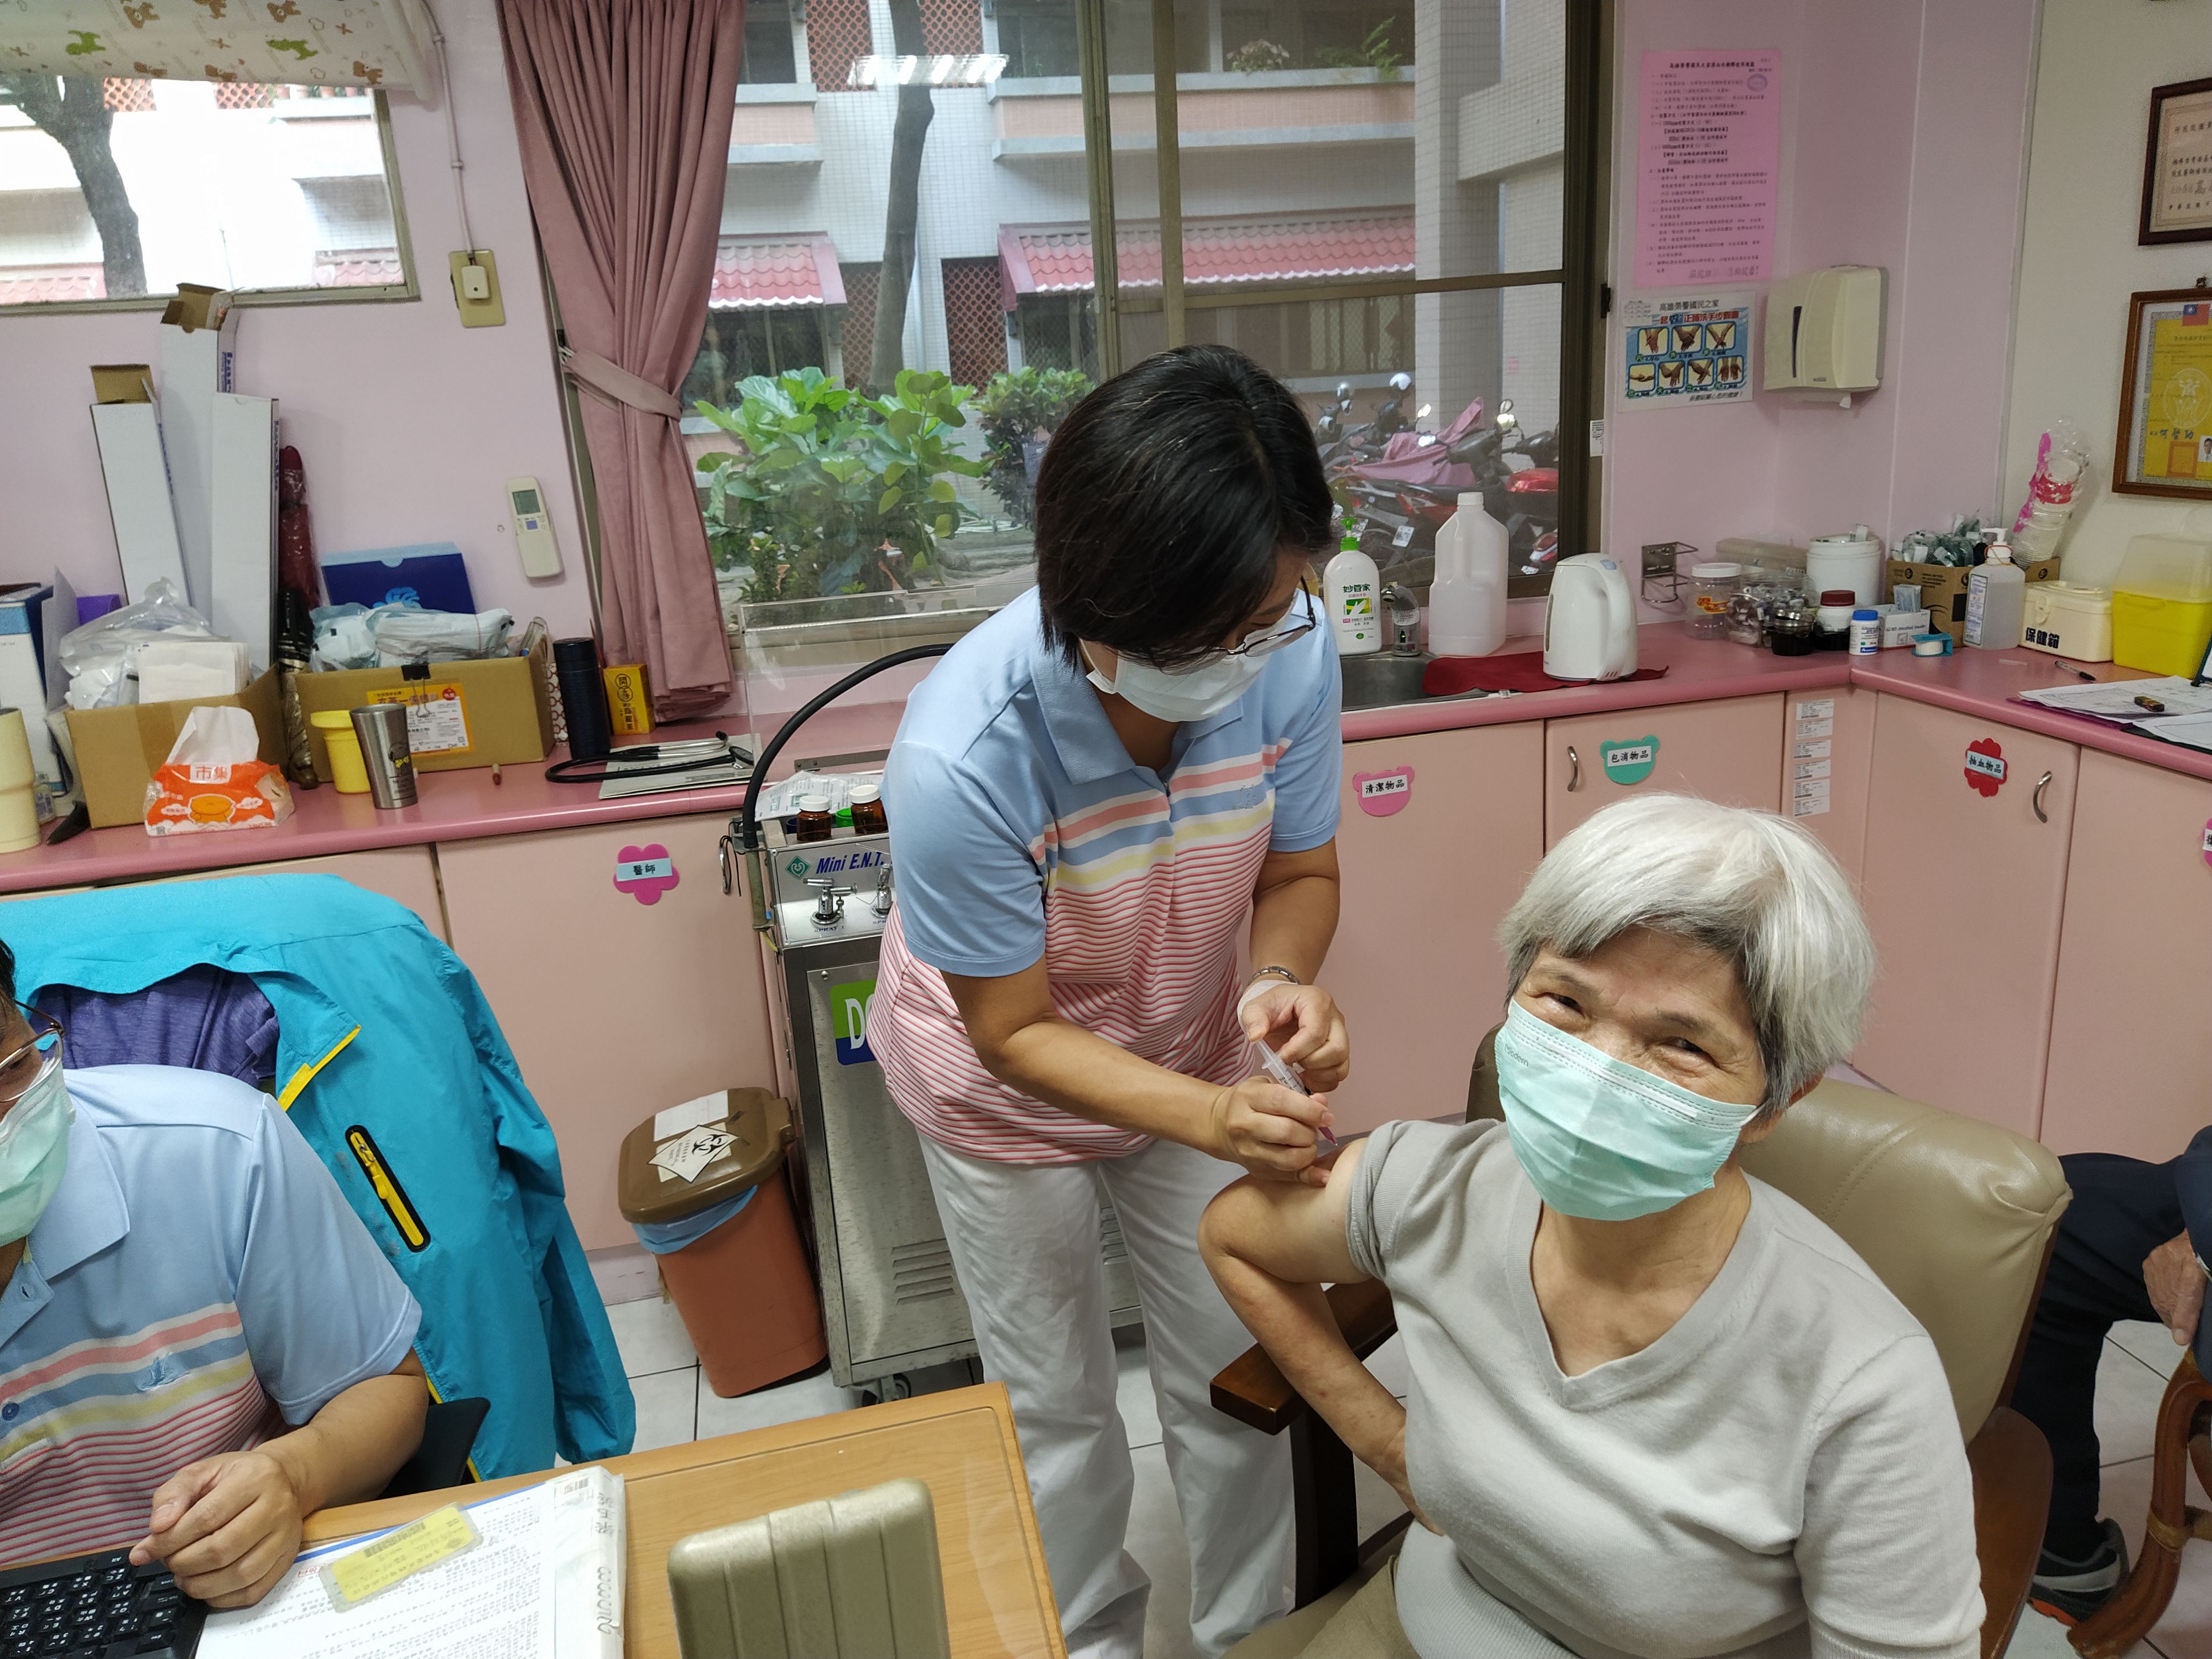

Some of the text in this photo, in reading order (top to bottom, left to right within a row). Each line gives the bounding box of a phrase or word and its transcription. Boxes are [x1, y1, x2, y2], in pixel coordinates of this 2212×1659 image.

[1343, 583, 1371, 593] 妙管家
[2026, 627, 2060, 649] 保健箱
[1969, 755, 2002, 774] 抽血物品
[195, 765, 228, 780] 市集
[1365, 779, 1405, 794] 清潔物品
[633, 863, 656, 875] 醫師
[816, 851, 884, 874] Mini E.N.T.
